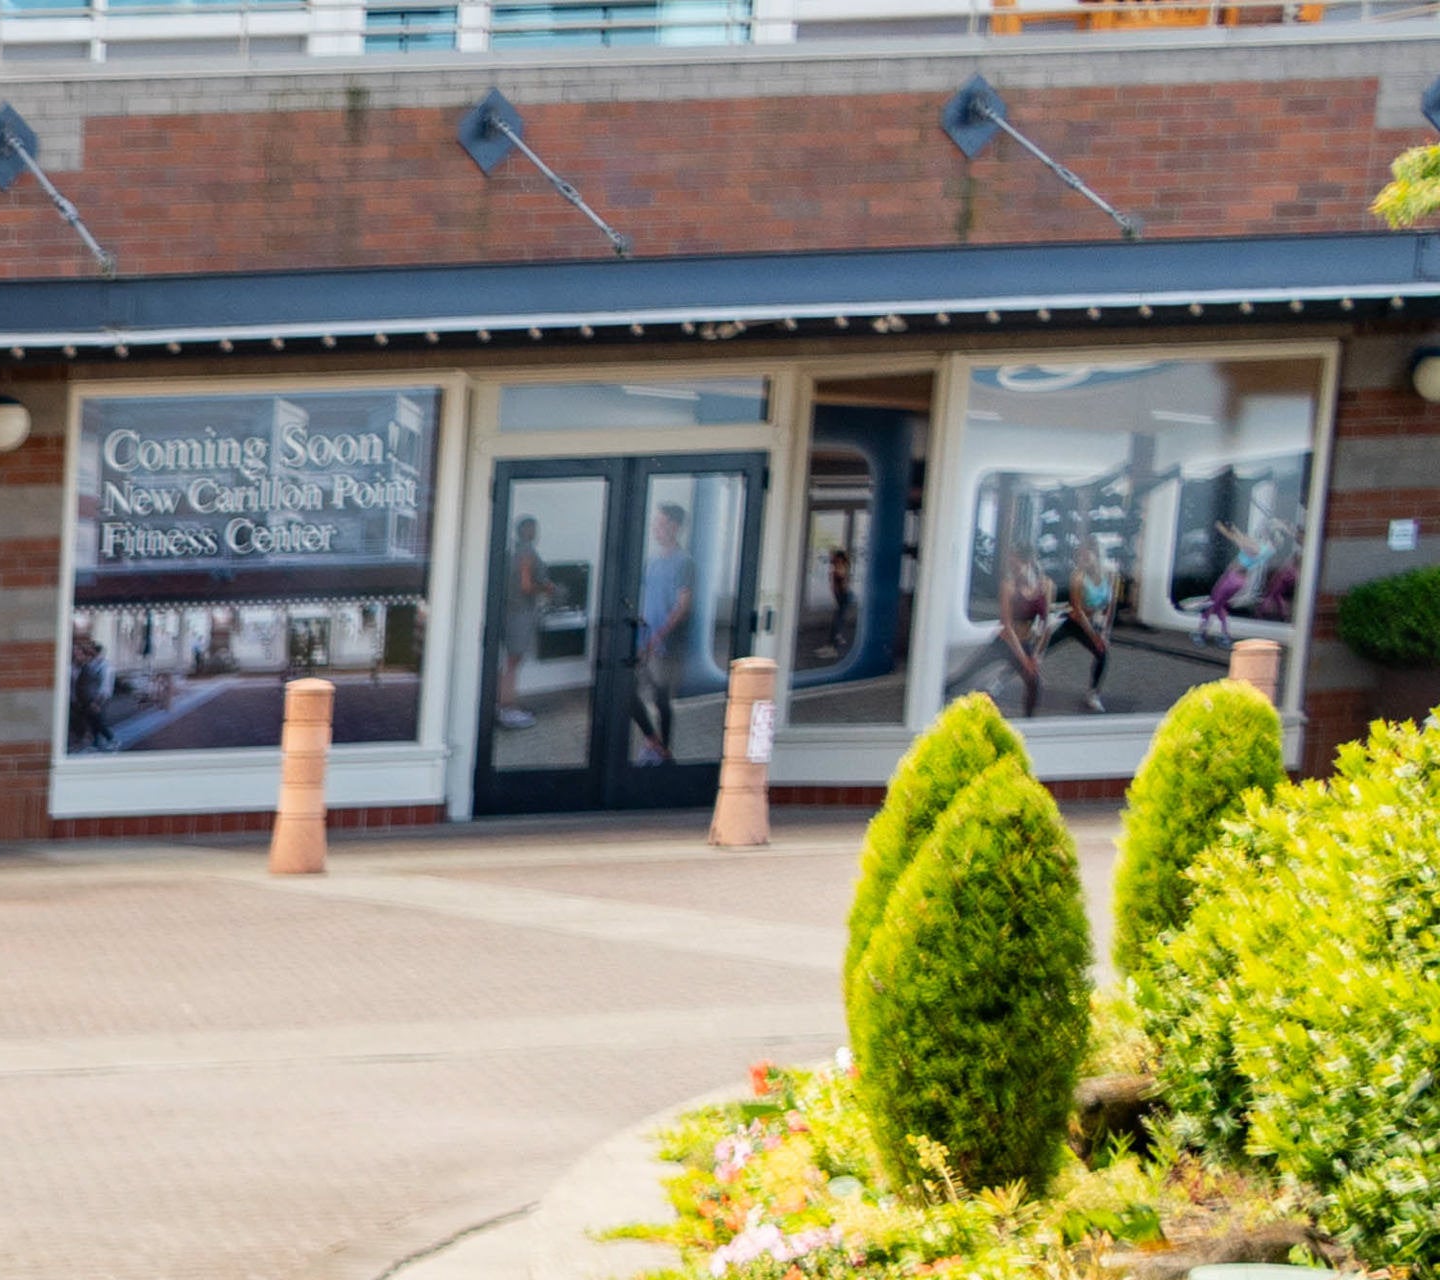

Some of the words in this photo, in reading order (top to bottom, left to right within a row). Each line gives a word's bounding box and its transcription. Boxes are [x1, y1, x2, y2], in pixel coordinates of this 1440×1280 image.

[104, 427, 269, 480] Coming
[280, 421, 400, 468] Soon!
[102, 480, 180, 516] New
[187, 475, 323, 514] Carillon
[331, 472, 418, 510] Point
[101, 521, 218, 559] Fitness
[225, 517, 337, 555] Center
